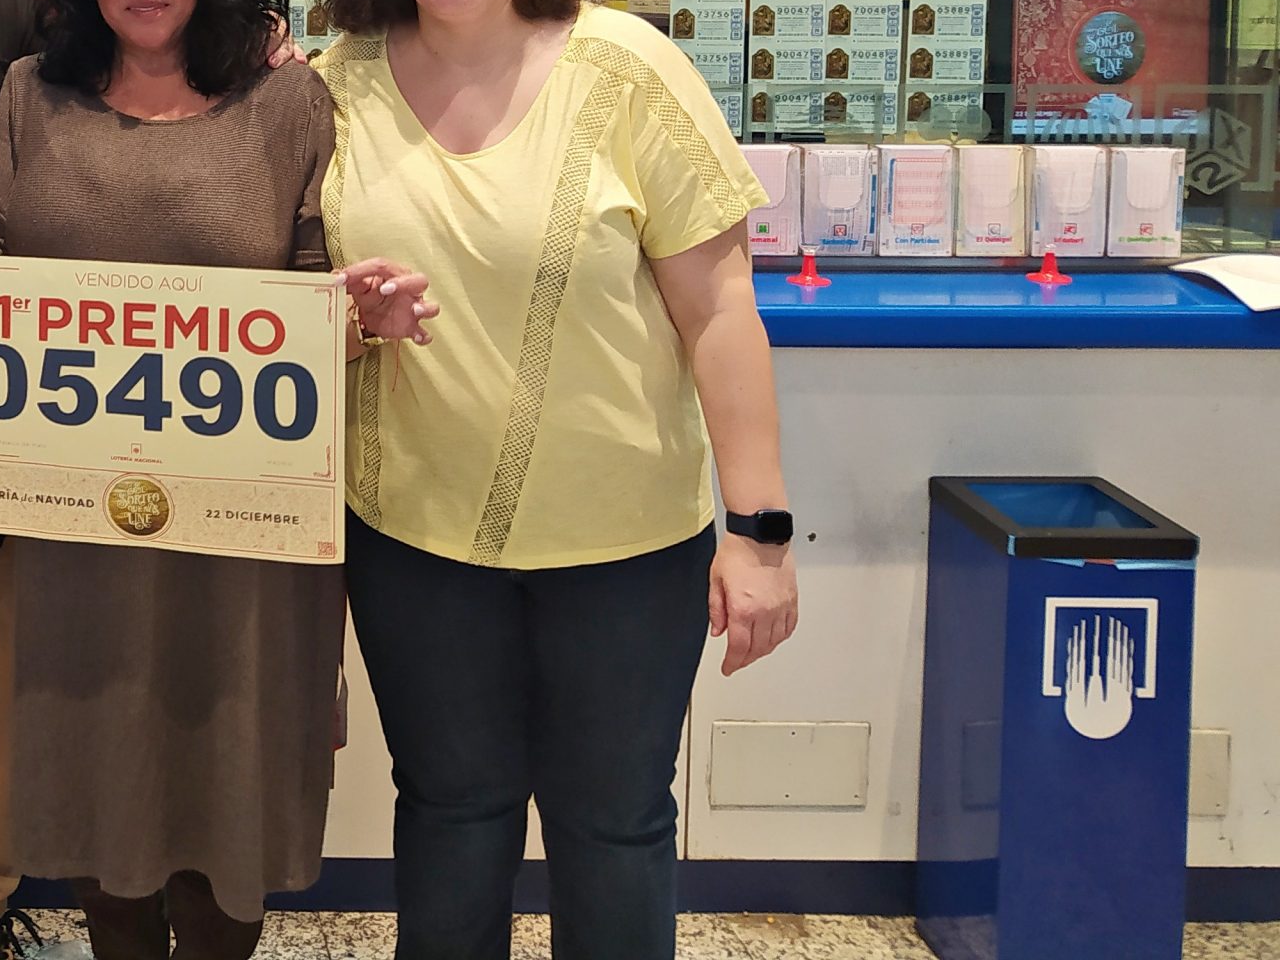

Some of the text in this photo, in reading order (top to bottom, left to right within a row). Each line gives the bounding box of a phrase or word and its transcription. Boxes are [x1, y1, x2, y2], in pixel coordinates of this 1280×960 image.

[697, 10, 730, 18] 73756
[695, 54, 728, 63] 73756
[776, 50, 809, 59] 90047
[775, 94, 808, 102] 90047
[75, 272, 203, 292] VENDIDO AQUÍ
[38, 297, 286, 356] PREMIO
[36, 495, 95, 509] NAVIDAD
[205, 509, 300, 525] 22 DICIEMBRE
